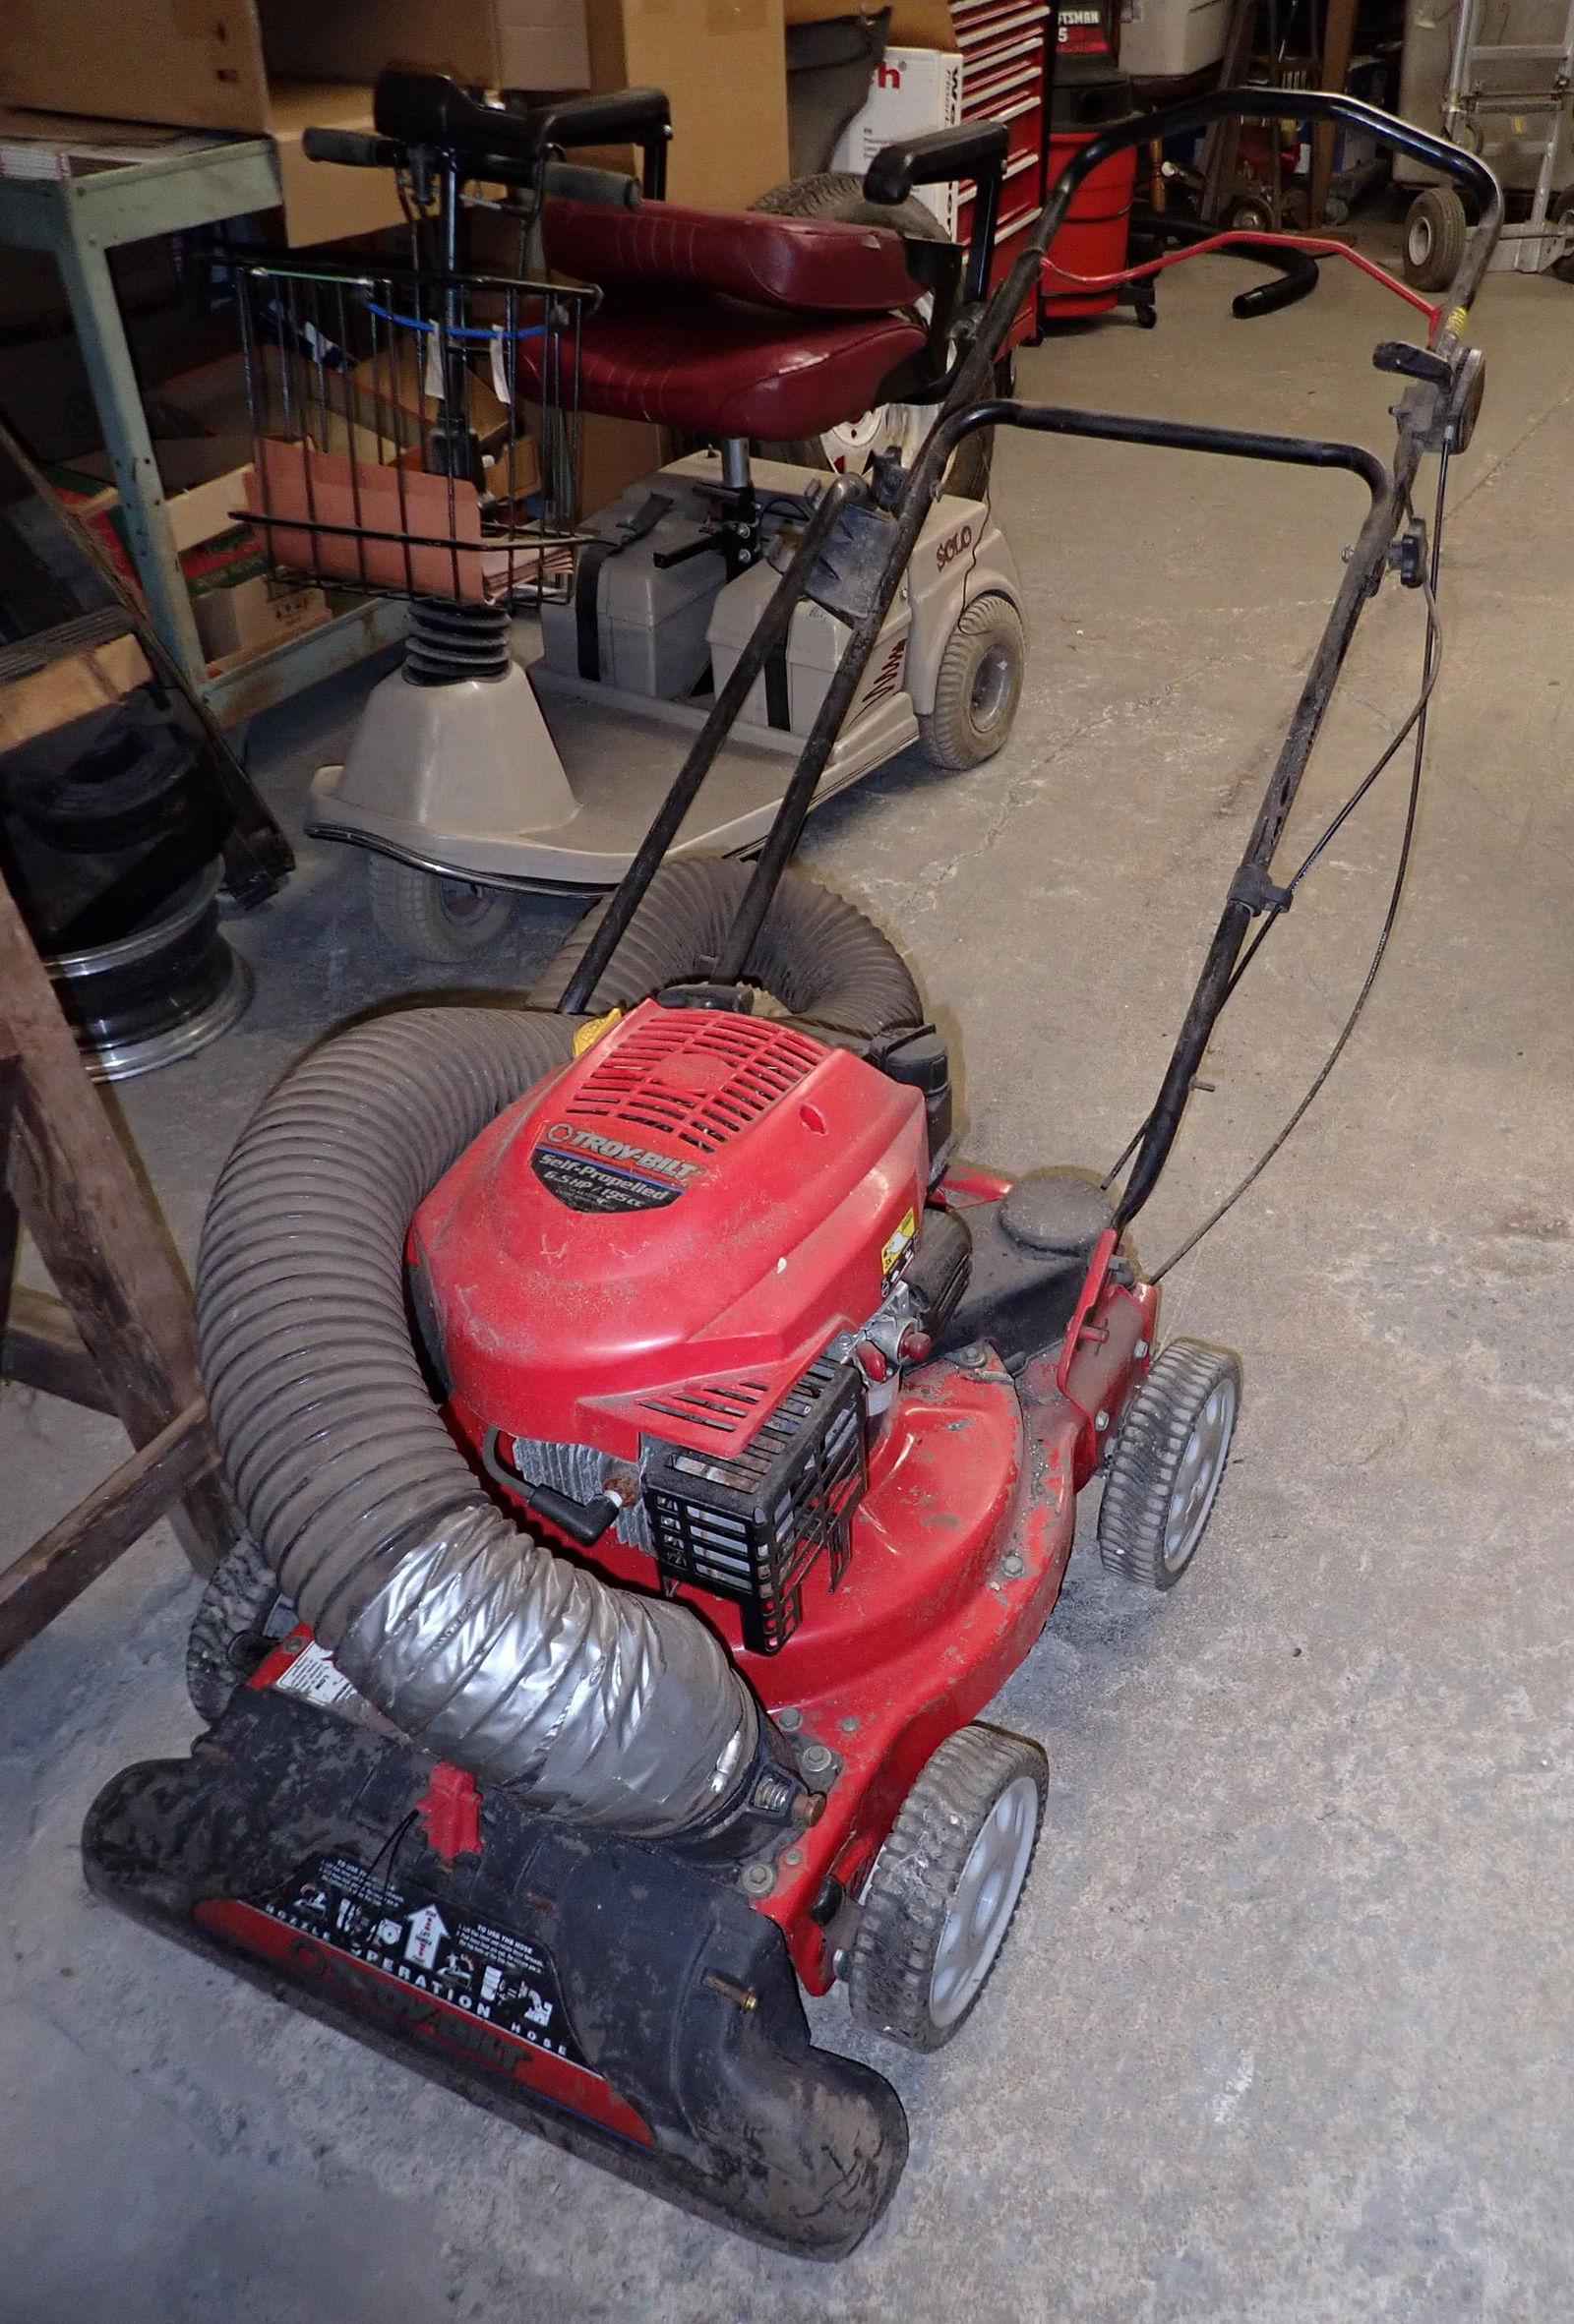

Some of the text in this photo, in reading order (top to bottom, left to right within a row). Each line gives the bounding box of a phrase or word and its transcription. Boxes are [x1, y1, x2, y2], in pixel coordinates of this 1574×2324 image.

[937, 525, 972, 572] SOLO
[539, 1154, 670, 1201] Self-Propelled
[570, 1130, 698, 1179] TROY-BILT
[544, 1170, 571, 1187] 6.5
[570, 1177, 593, 1190] HP
[600, 1187, 627, 1203] 195
[477, 1924, 488, 1935] TO
[487, 1928, 501, 1940] USE
[501, 1934, 515, 1946] THE
[350, 1941, 492, 2018] OPERATION
[511, 2021, 568, 2056] HOSE
